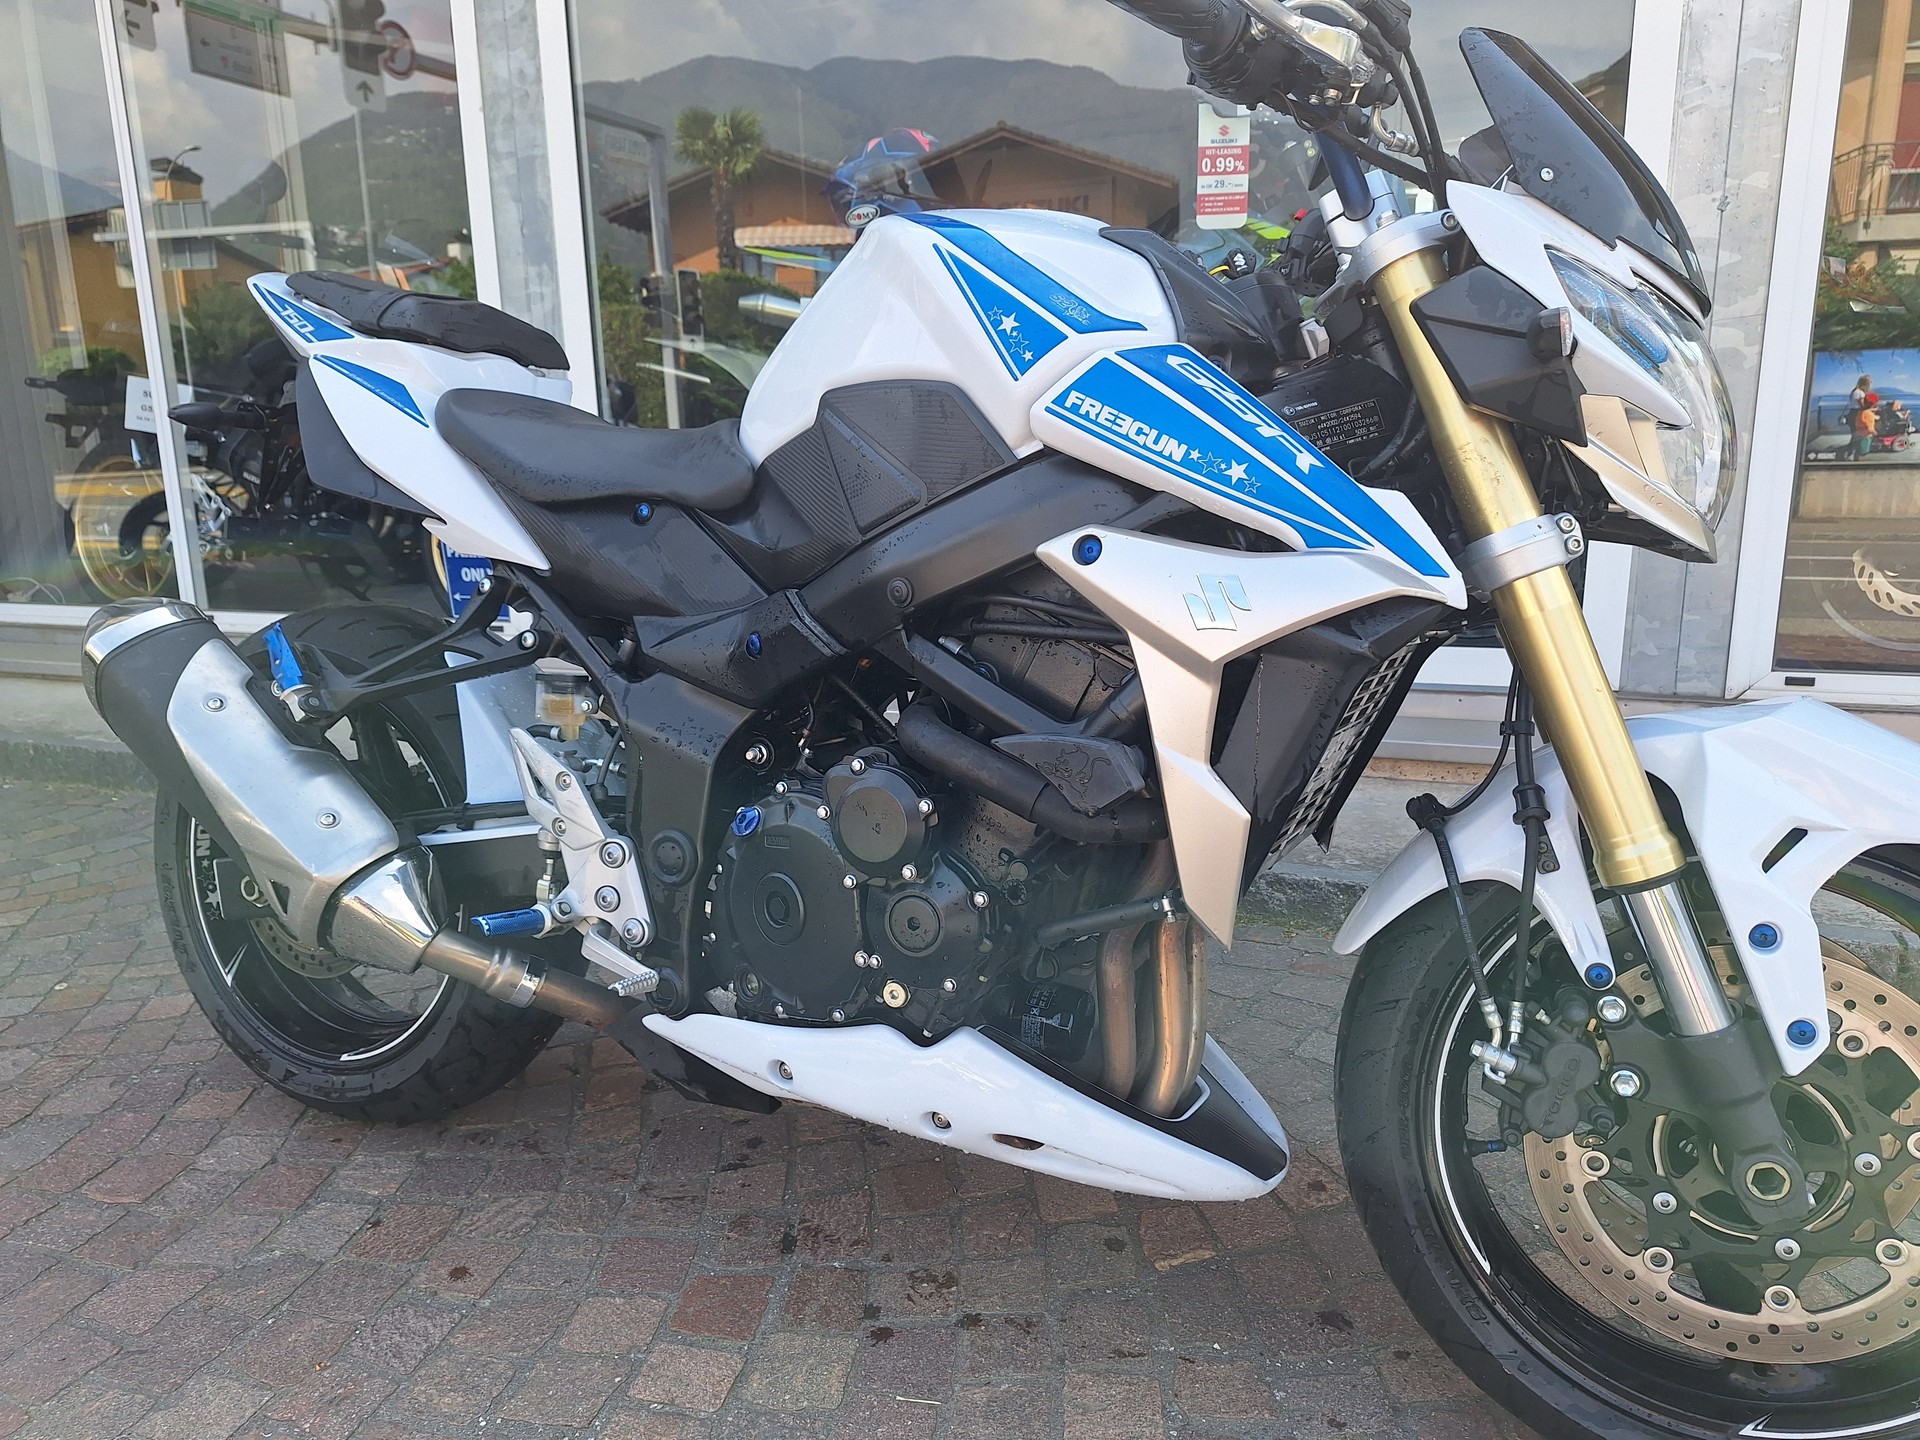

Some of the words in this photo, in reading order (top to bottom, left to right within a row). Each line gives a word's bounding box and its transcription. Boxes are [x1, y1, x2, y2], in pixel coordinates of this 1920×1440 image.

[1201, 156, 1245, 173] 0.99%
[1205, 147, 1242, 155] HIT-LEASING
[280, 303, 316, 335] 750
[1063, 389, 1189, 463] FREEGUN
[1298, 417, 1318, 427] SUZUKI
[1320, 412, 1337, 421] MOTOR
[1339, 401, 1375, 415] CORPORATION
[1541, 1057, 1579, 1129] TOKICO
